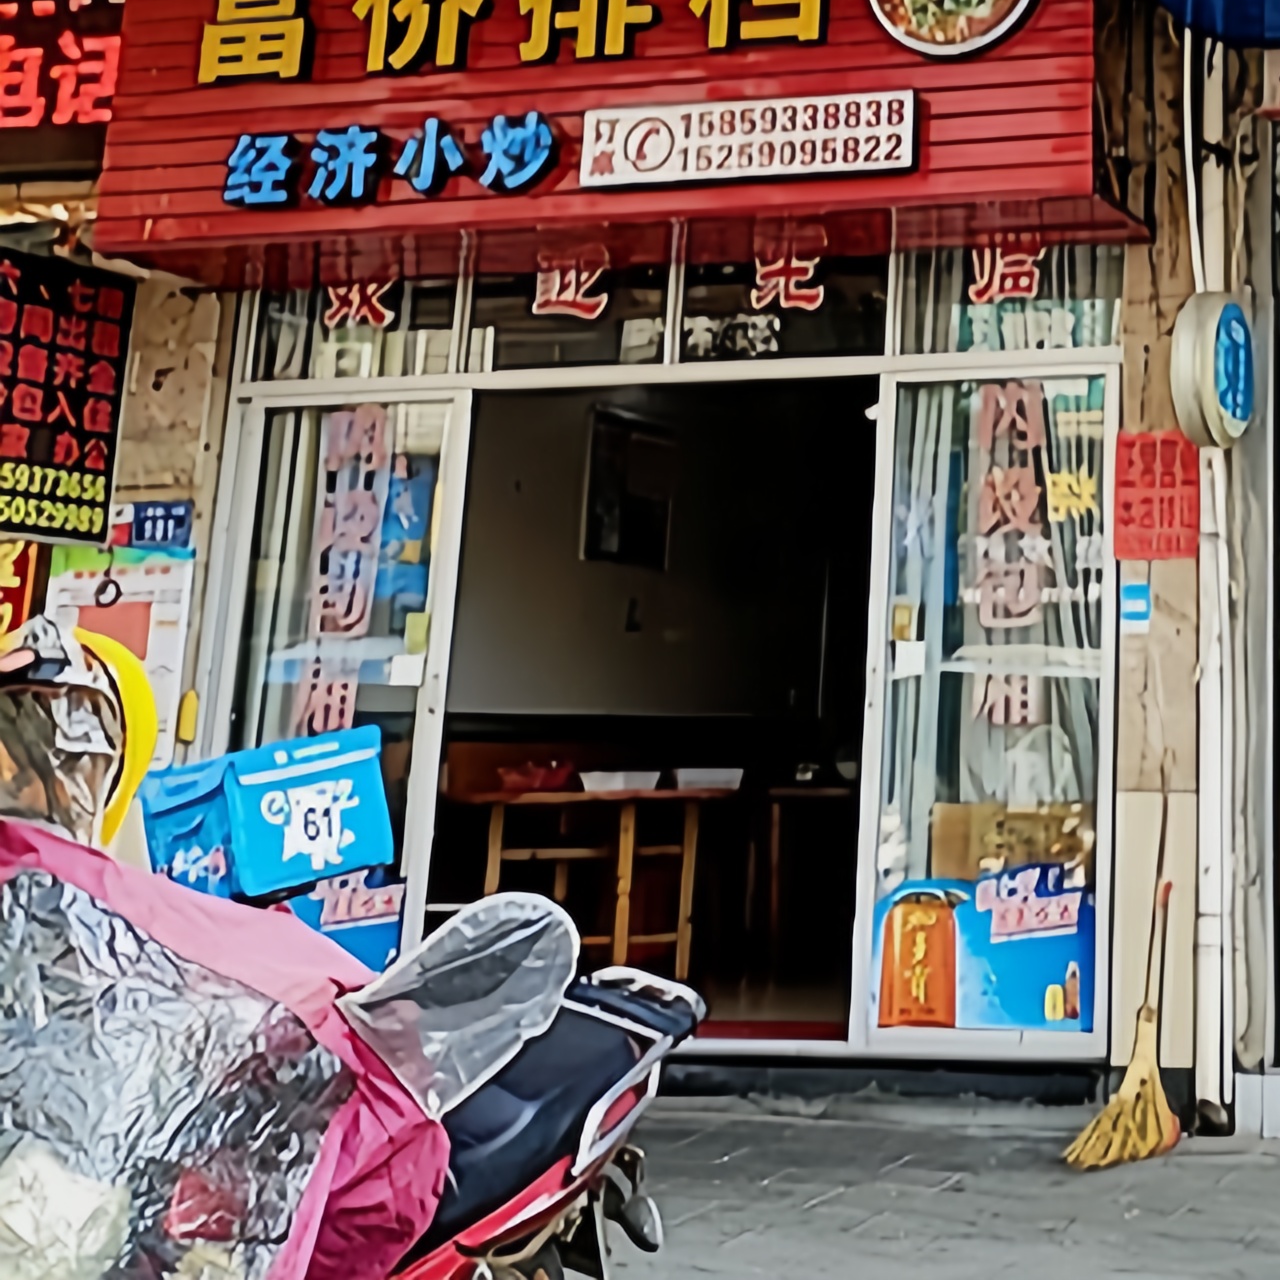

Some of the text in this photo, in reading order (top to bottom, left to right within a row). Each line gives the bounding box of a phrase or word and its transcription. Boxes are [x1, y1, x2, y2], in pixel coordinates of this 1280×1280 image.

[680, 98, 905, 139] 15859338838
[223, 111, 554, 204] 经济小炒
[677, 133, 902, 172] 15259095822
